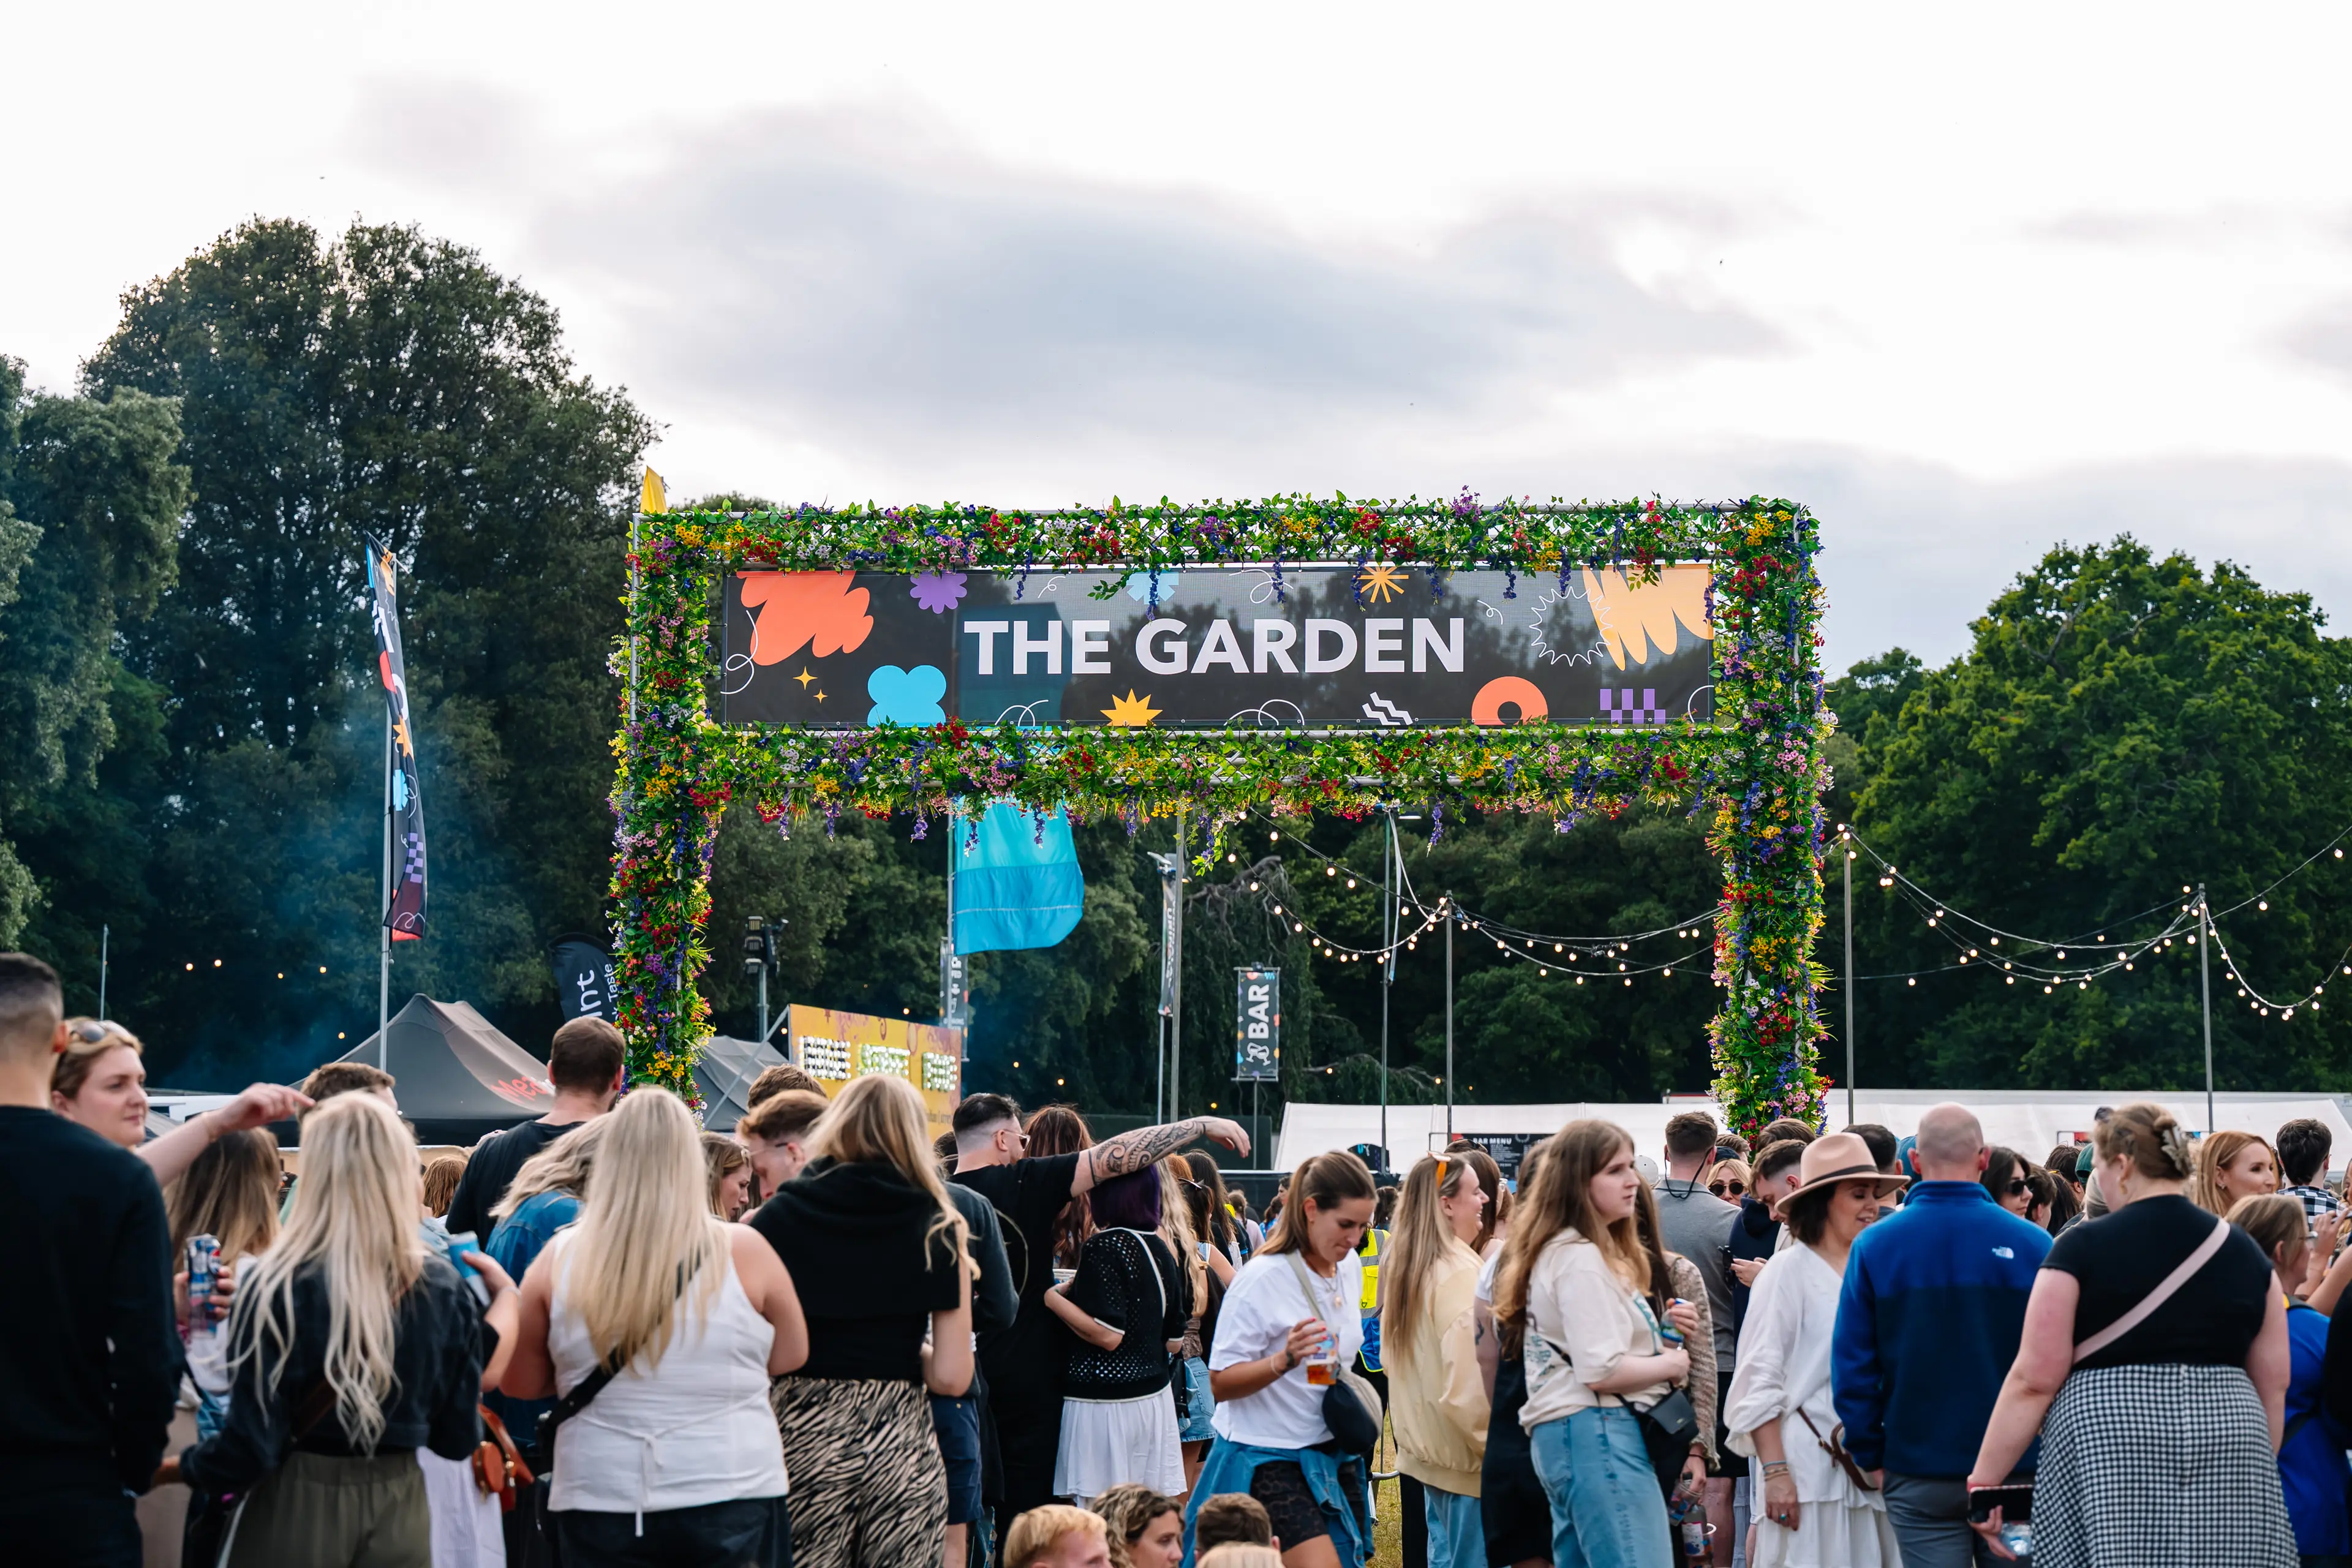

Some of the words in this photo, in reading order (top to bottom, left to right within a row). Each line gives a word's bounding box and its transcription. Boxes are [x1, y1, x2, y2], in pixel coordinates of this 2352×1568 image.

[964, 619, 1111, 675] THE
[1136, 617, 1464, 675] GARDEN
[604, 963, 619, 1003] Taste
[1248, 984, 1270, 1039] BAR
